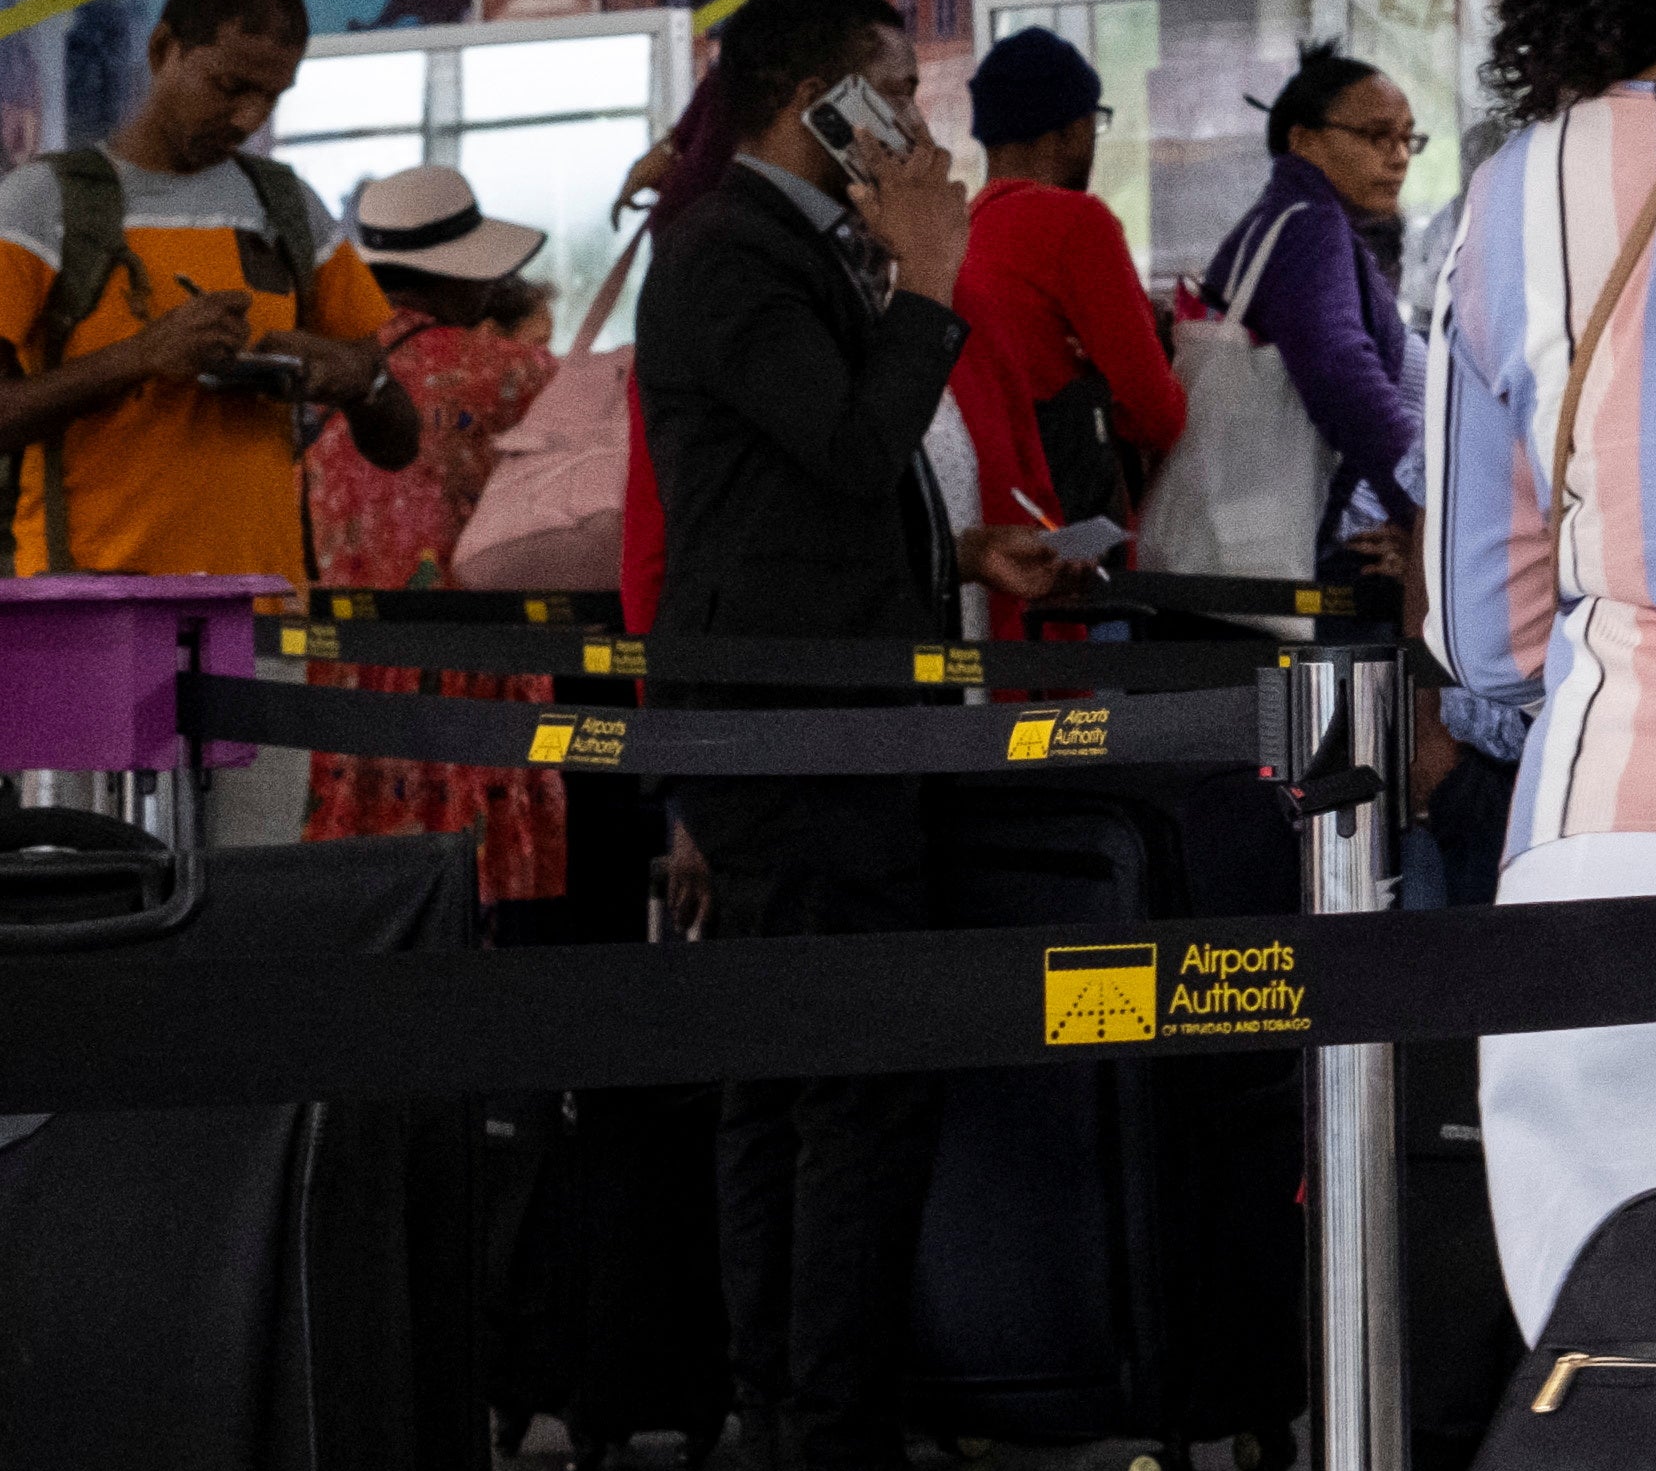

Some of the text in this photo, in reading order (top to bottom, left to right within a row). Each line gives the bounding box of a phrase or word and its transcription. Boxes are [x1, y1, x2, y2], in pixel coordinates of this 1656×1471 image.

[1052, 727, 1108, 746] Authority
[1180, 939, 1295, 980] Airports
[1168, 979, 1306, 1016] Authority
[1234, 1019, 1261, 1034] AND
